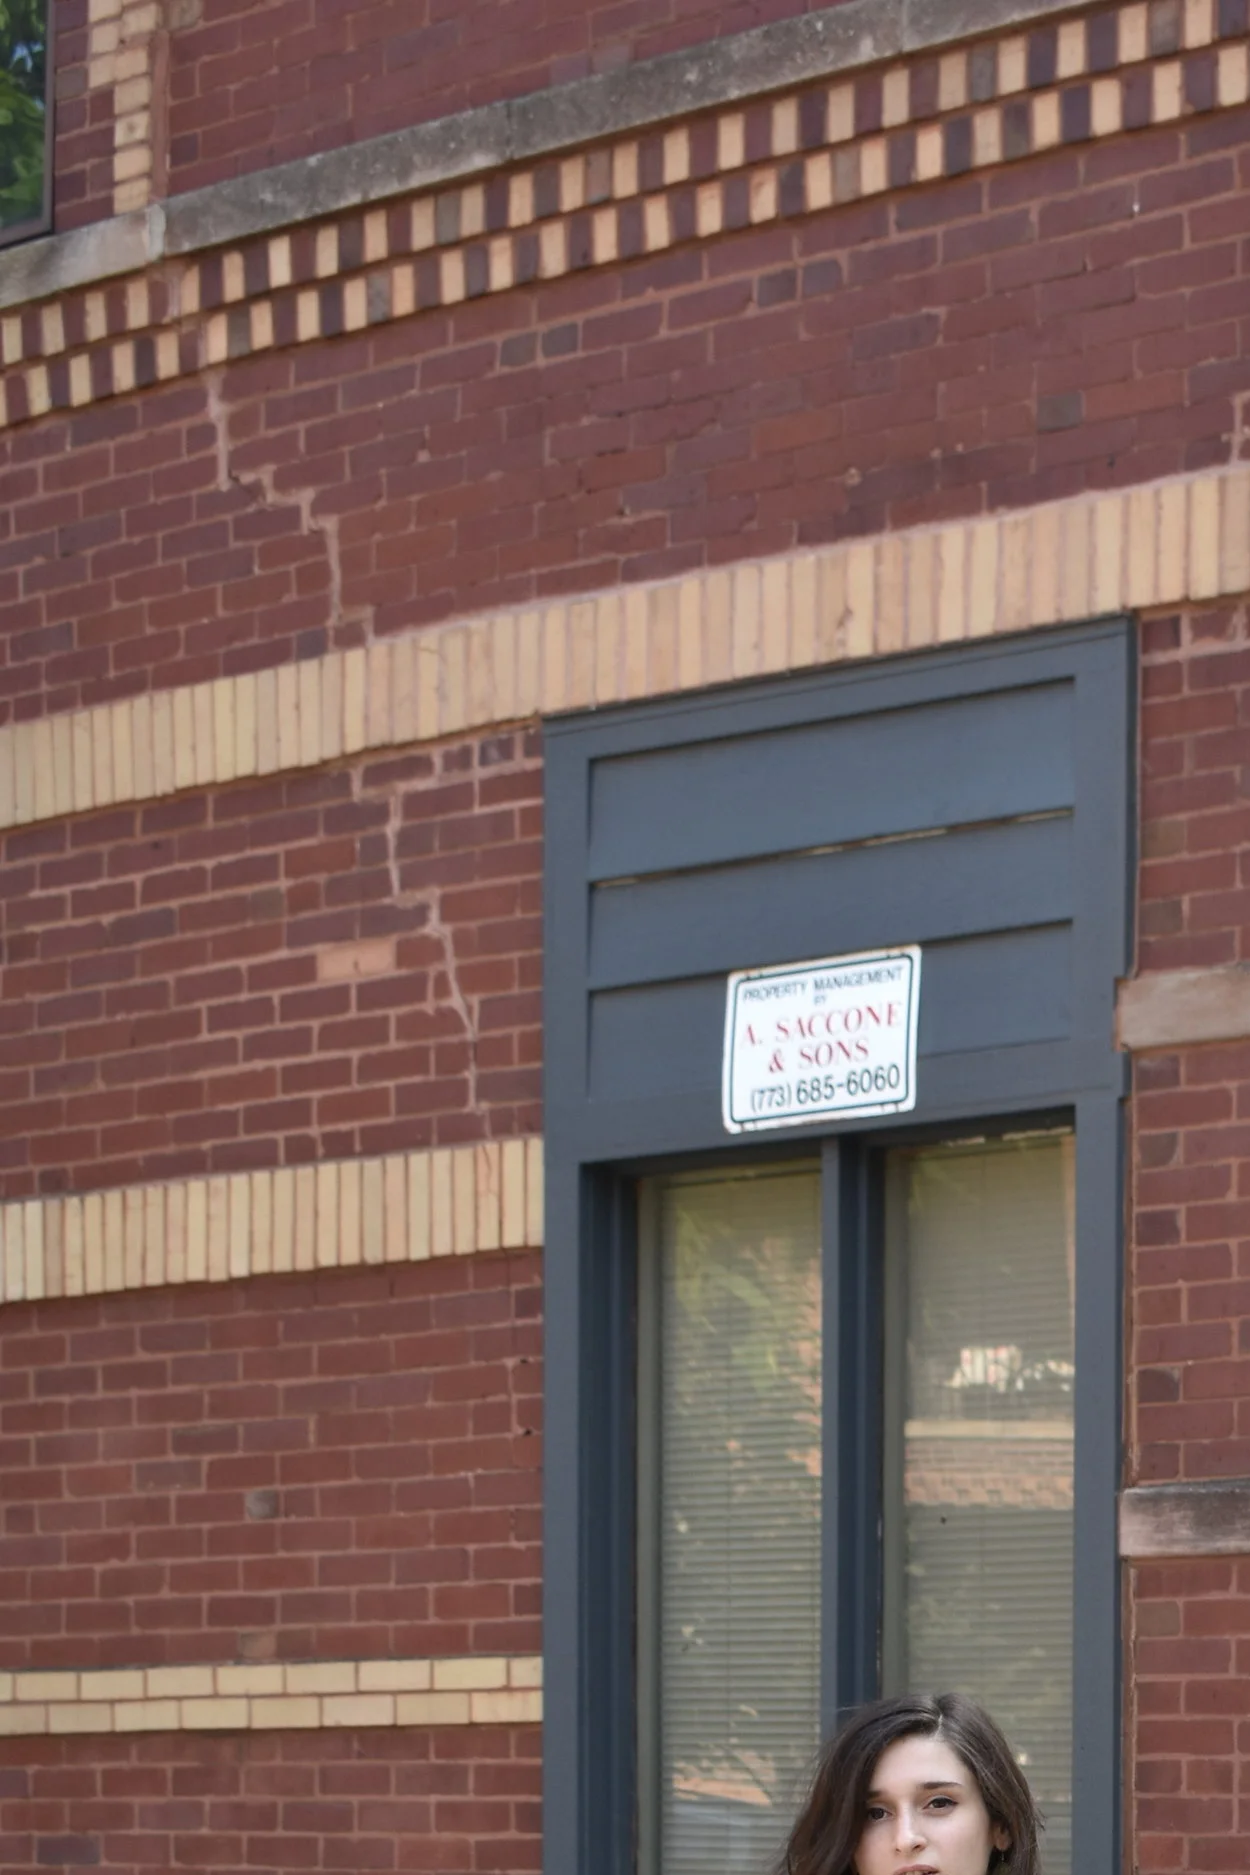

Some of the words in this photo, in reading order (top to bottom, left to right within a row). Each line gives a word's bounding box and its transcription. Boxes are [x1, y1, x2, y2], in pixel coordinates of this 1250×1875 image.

[743, 980, 808, 1002] PROPERTY
[813, 966, 905, 991] MANAGEMENT
[813, 995, 827, 1005] BY
[741, 1024, 762, 1048] A.
[776, 1002, 902, 1042] SACCONE
[767, 1049, 784, 1074] &
[798, 1038, 870, 1069] SONS
[751, 1084, 792, 1112] (773)
[796, 1064, 900, 1105] 685-6060
